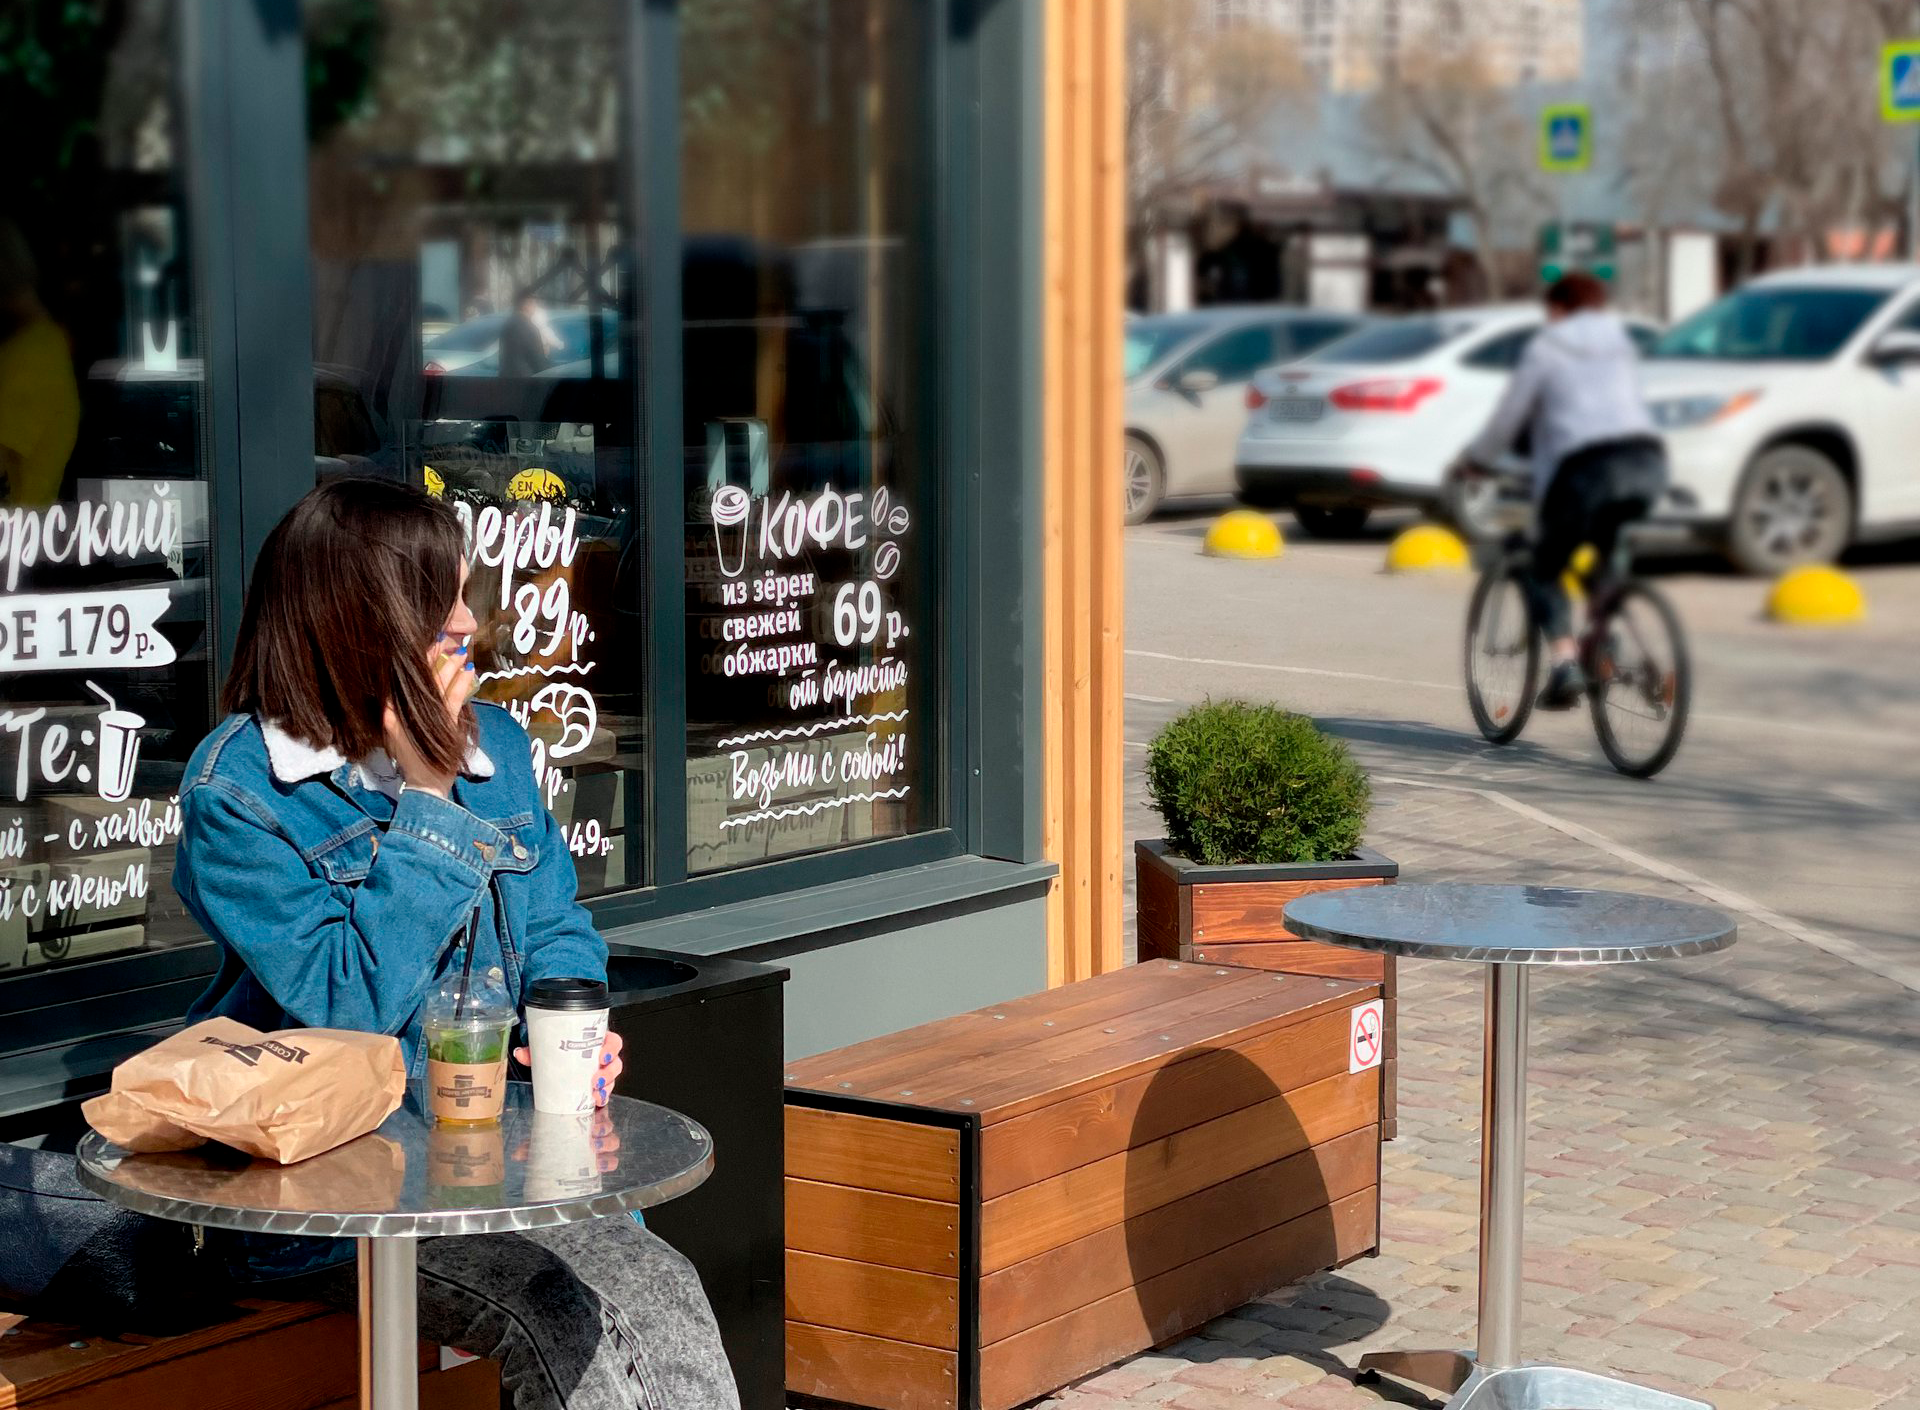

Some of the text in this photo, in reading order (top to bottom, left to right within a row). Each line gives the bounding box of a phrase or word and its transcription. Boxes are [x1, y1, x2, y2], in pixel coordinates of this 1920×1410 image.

[759, 482, 867, 560] КОФЕ
[722, 570, 814, 606] из зёрен
[722, 602, 801, 642] свежей
[723, 642, 817, 677] обжарки
[789, 657, 908, 715] от бариста
[729, 732, 906, 810] Возьми с собой!
[69, 818, 88, 850] с
[93, 795, 183, 848] халвой
[22, 885, 40, 917] с
[47, 864, 148, 917] кленом
